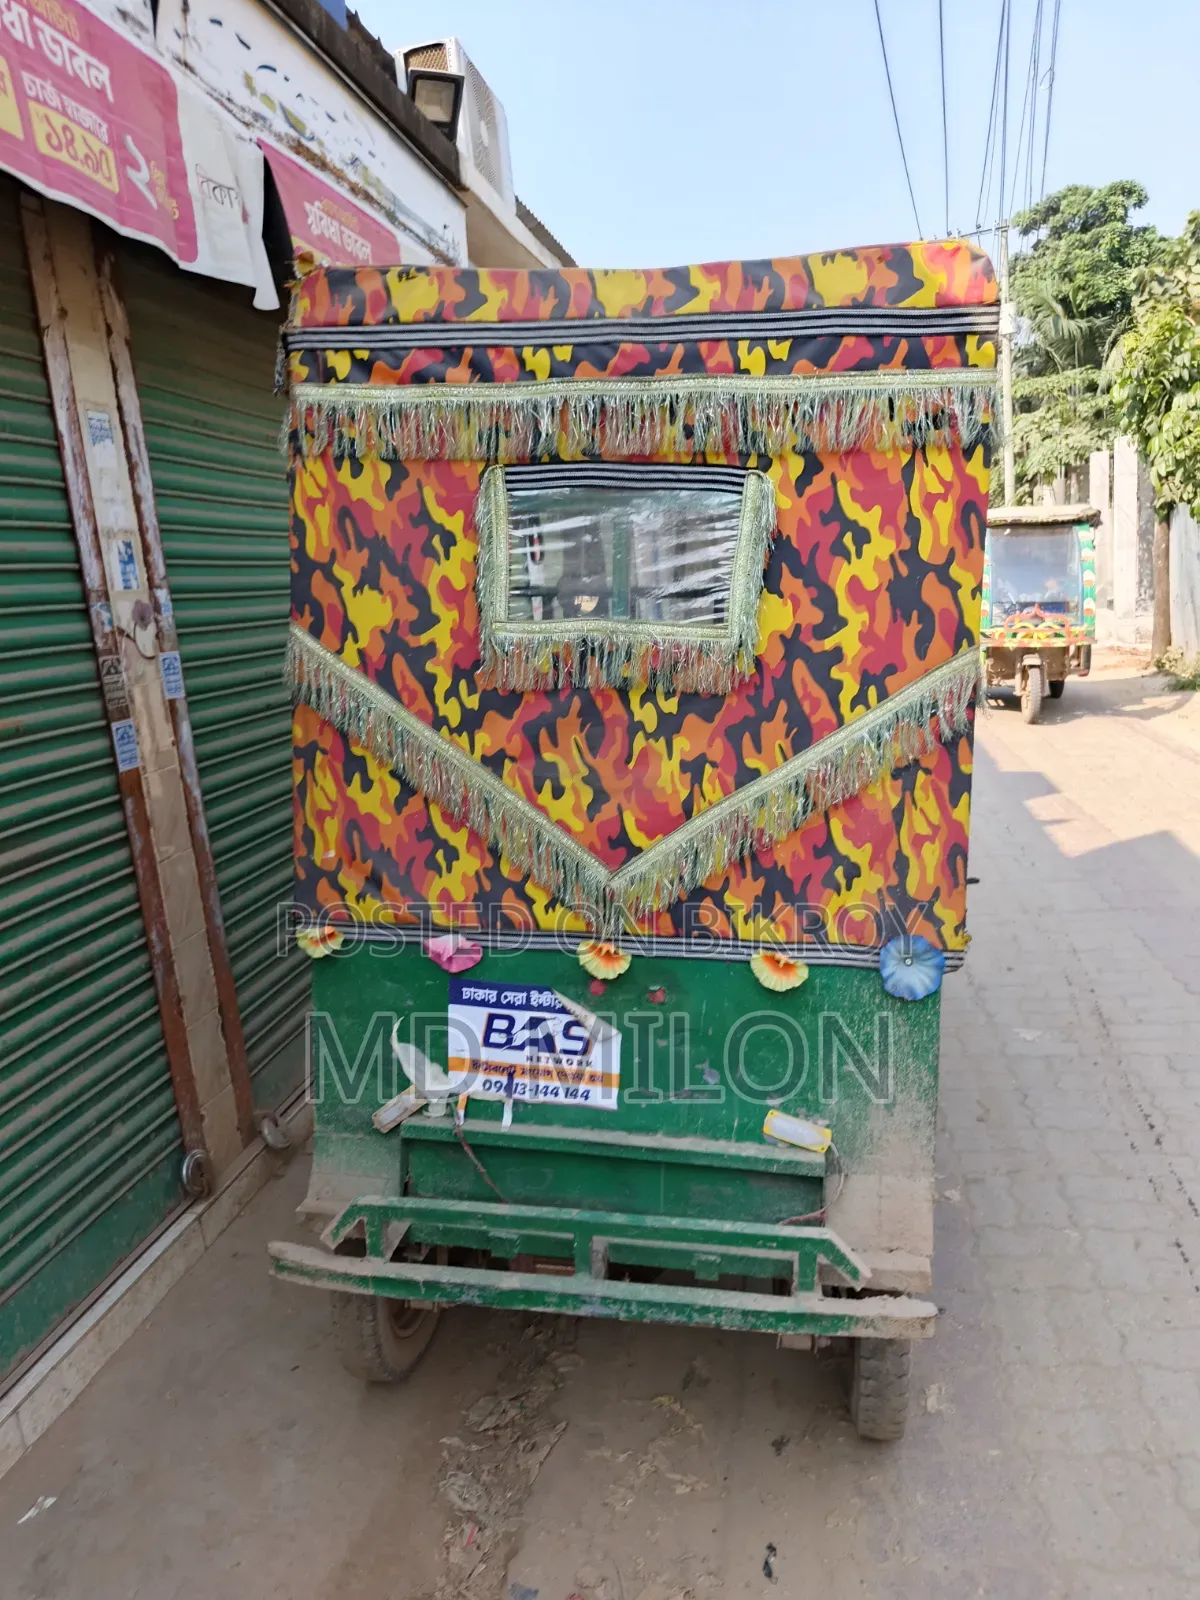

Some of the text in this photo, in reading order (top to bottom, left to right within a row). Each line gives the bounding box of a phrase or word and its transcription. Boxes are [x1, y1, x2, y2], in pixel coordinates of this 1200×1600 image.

[33, 14, 115, 104] ডাবল
[21, 69, 63, 112] চার্জ
[43, 112, 113, 183] ১৪.৯০
[461, 986, 498, 1004] ঢাকার
[500, 991, 527, 1006] সেরা
[482, 1011, 592, 1057] BAS
[482, 1078, 560, 1098] 0913-144
